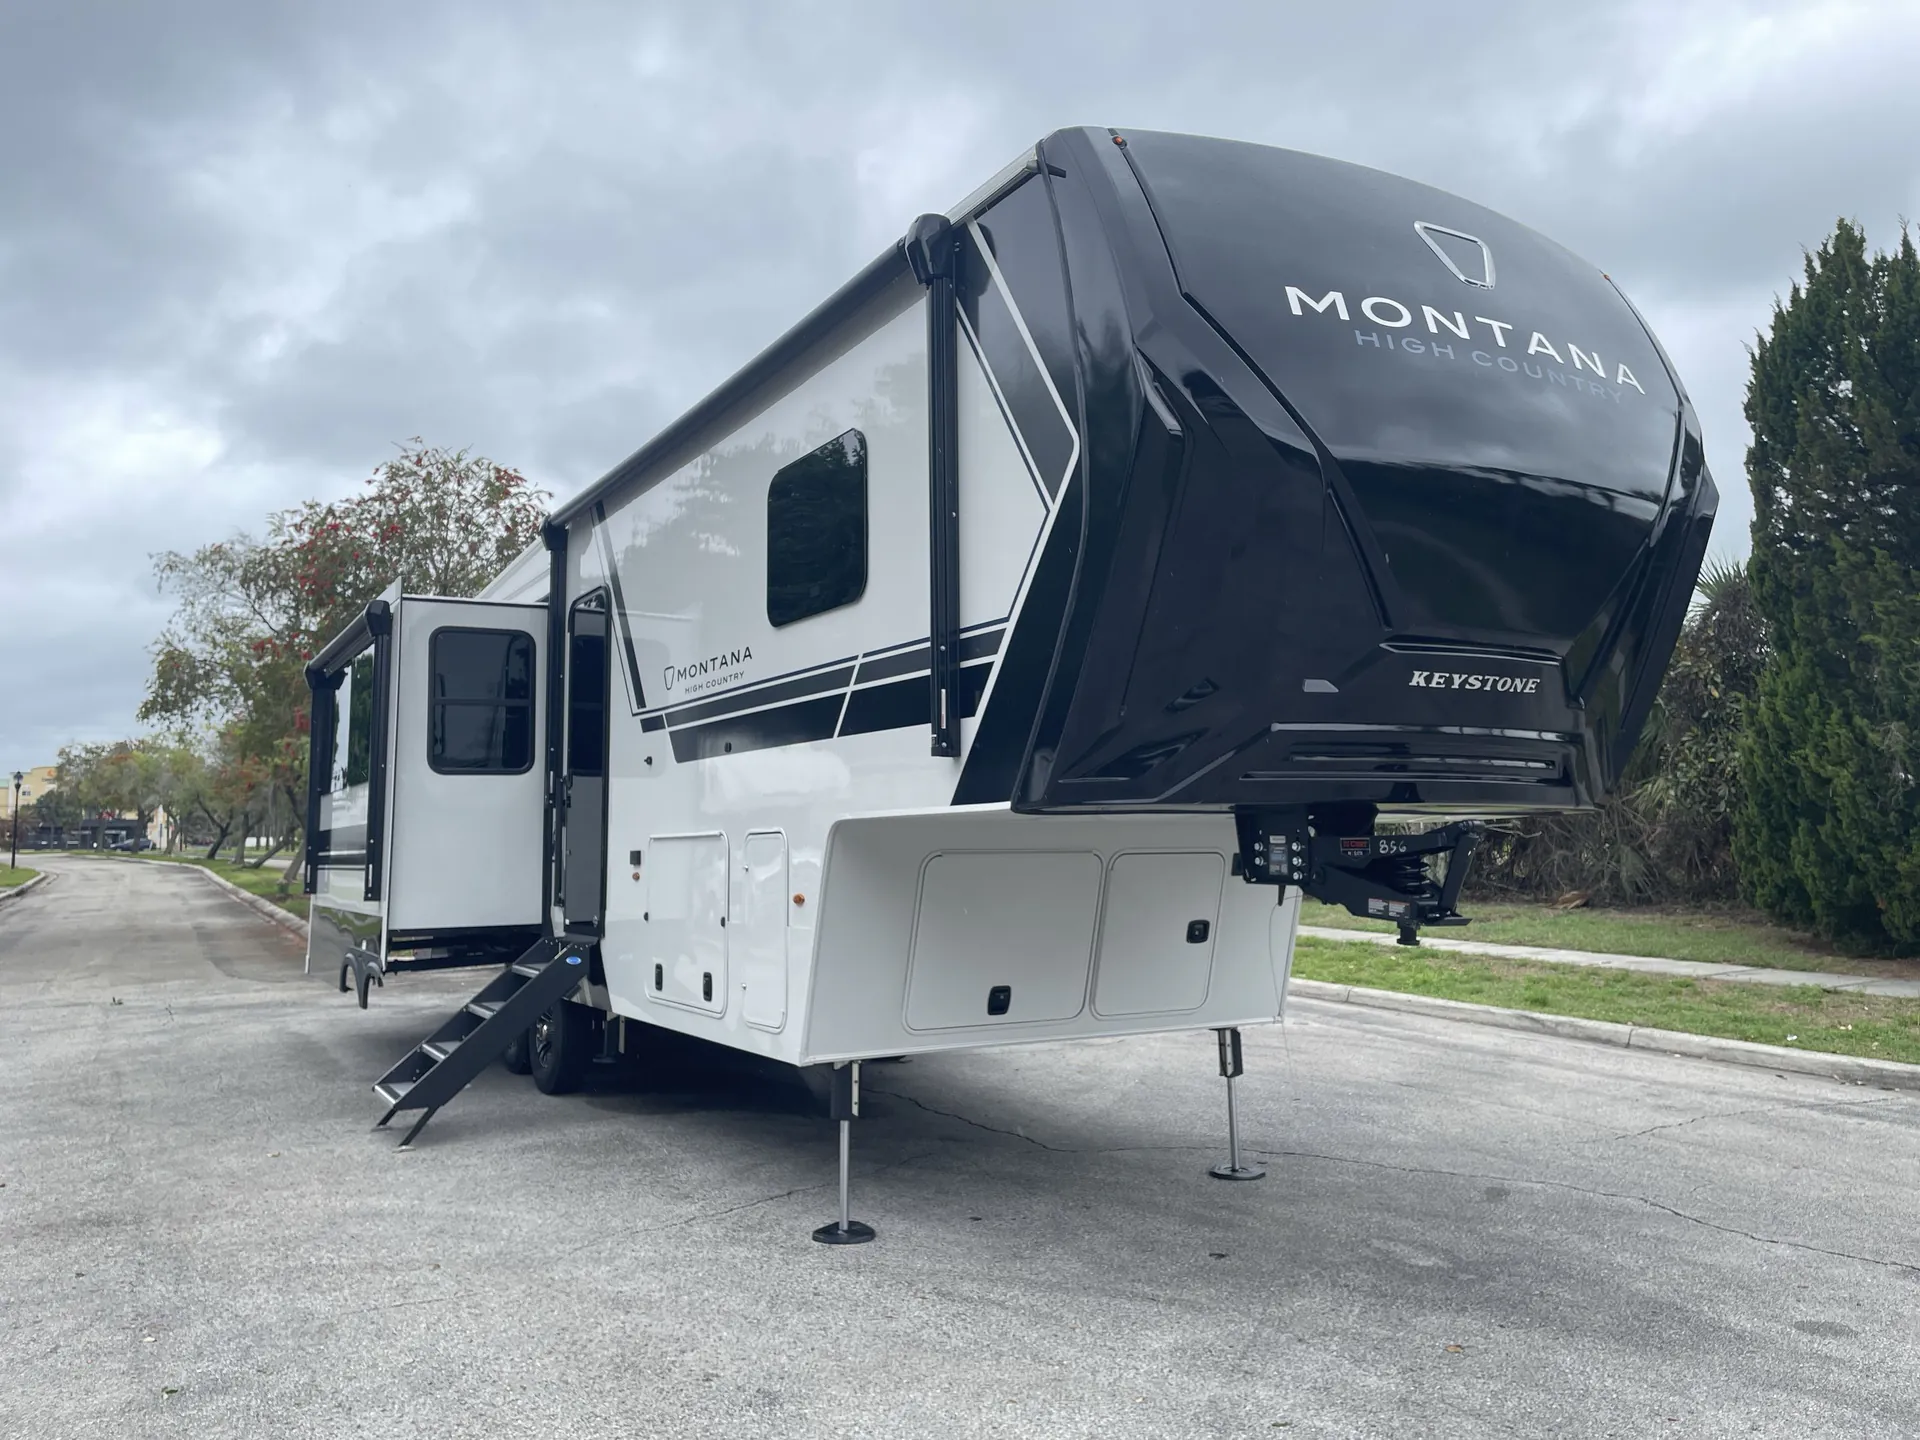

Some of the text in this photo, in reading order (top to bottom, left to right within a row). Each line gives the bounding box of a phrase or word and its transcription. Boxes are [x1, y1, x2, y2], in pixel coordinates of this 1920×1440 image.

[1284, 286, 1646, 395] MONTANA
[1354, 329, 1623, 404] HIGH COUNTRY
[677, 646, 753, 682] MONTANA
[1408, 670, 1541, 694] KEYSTONE
[684, 671, 745, 695] HIGH COUNTRY
